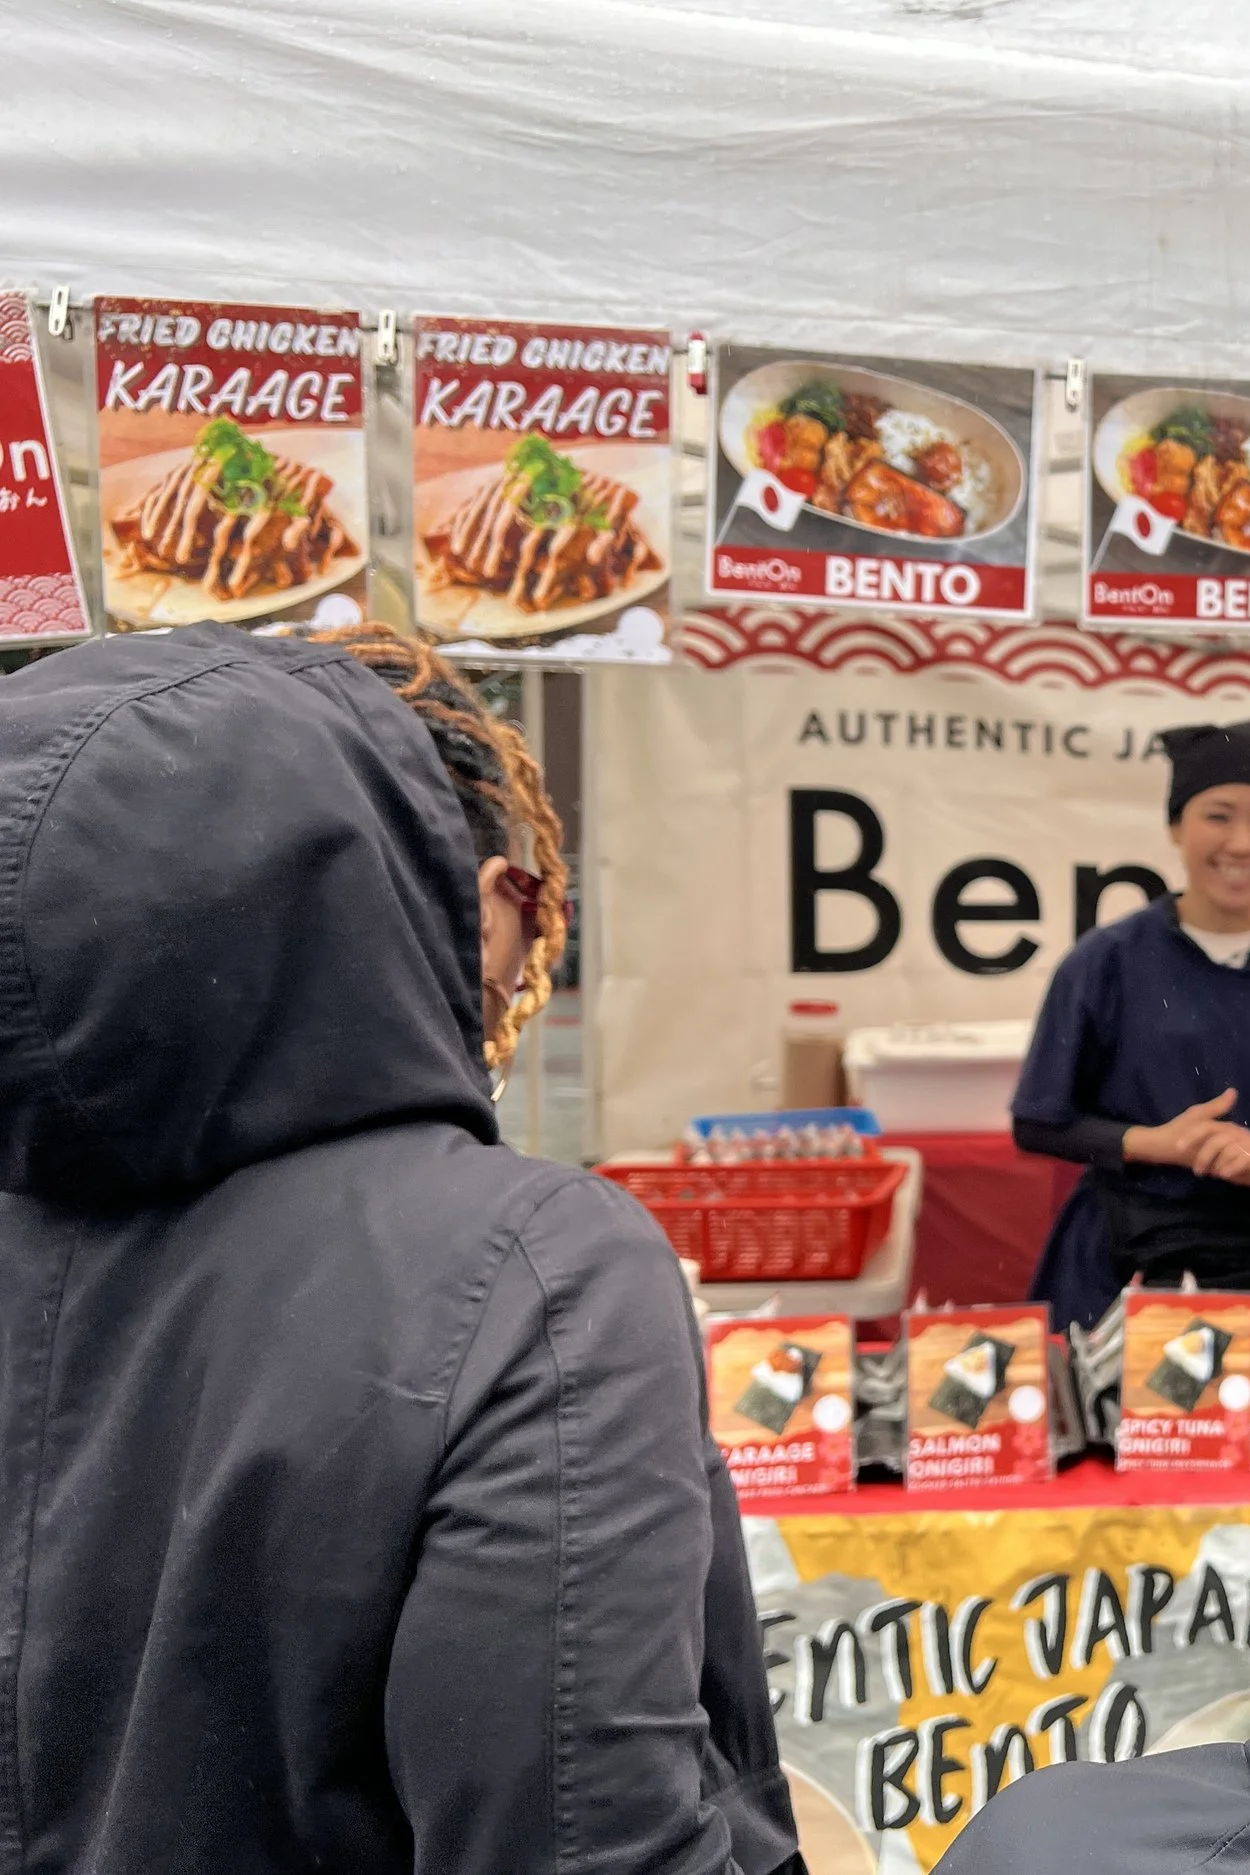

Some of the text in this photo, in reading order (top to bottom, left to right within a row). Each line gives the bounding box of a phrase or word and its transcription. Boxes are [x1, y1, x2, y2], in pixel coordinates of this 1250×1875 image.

[98, 312, 361, 358] FRIED CHICKEN
[415, 331, 670, 376] FRIED CHICKEN
[105, 359, 355, 423] KARAAGE
[420, 377, 663, 438] KARAAGE
[0, 439, 50, 482] n
[717, 554, 802, 583] BentOn
[825, 555, 981, 606] BENTO
[1094, 581, 1174, 606] BentOn
[798, 709, 1091, 760] AUTHENTIC
[908, 1432, 1002, 1458] SALMON
[1119, 1417, 1225, 1437] SPICY TUNA
[1118, 1436, 1192, 1455] ONIGIRI
[730, 1463, 798, 1488] NIGIRI
[908, 1455, 995, 1480] ONIGIRI
